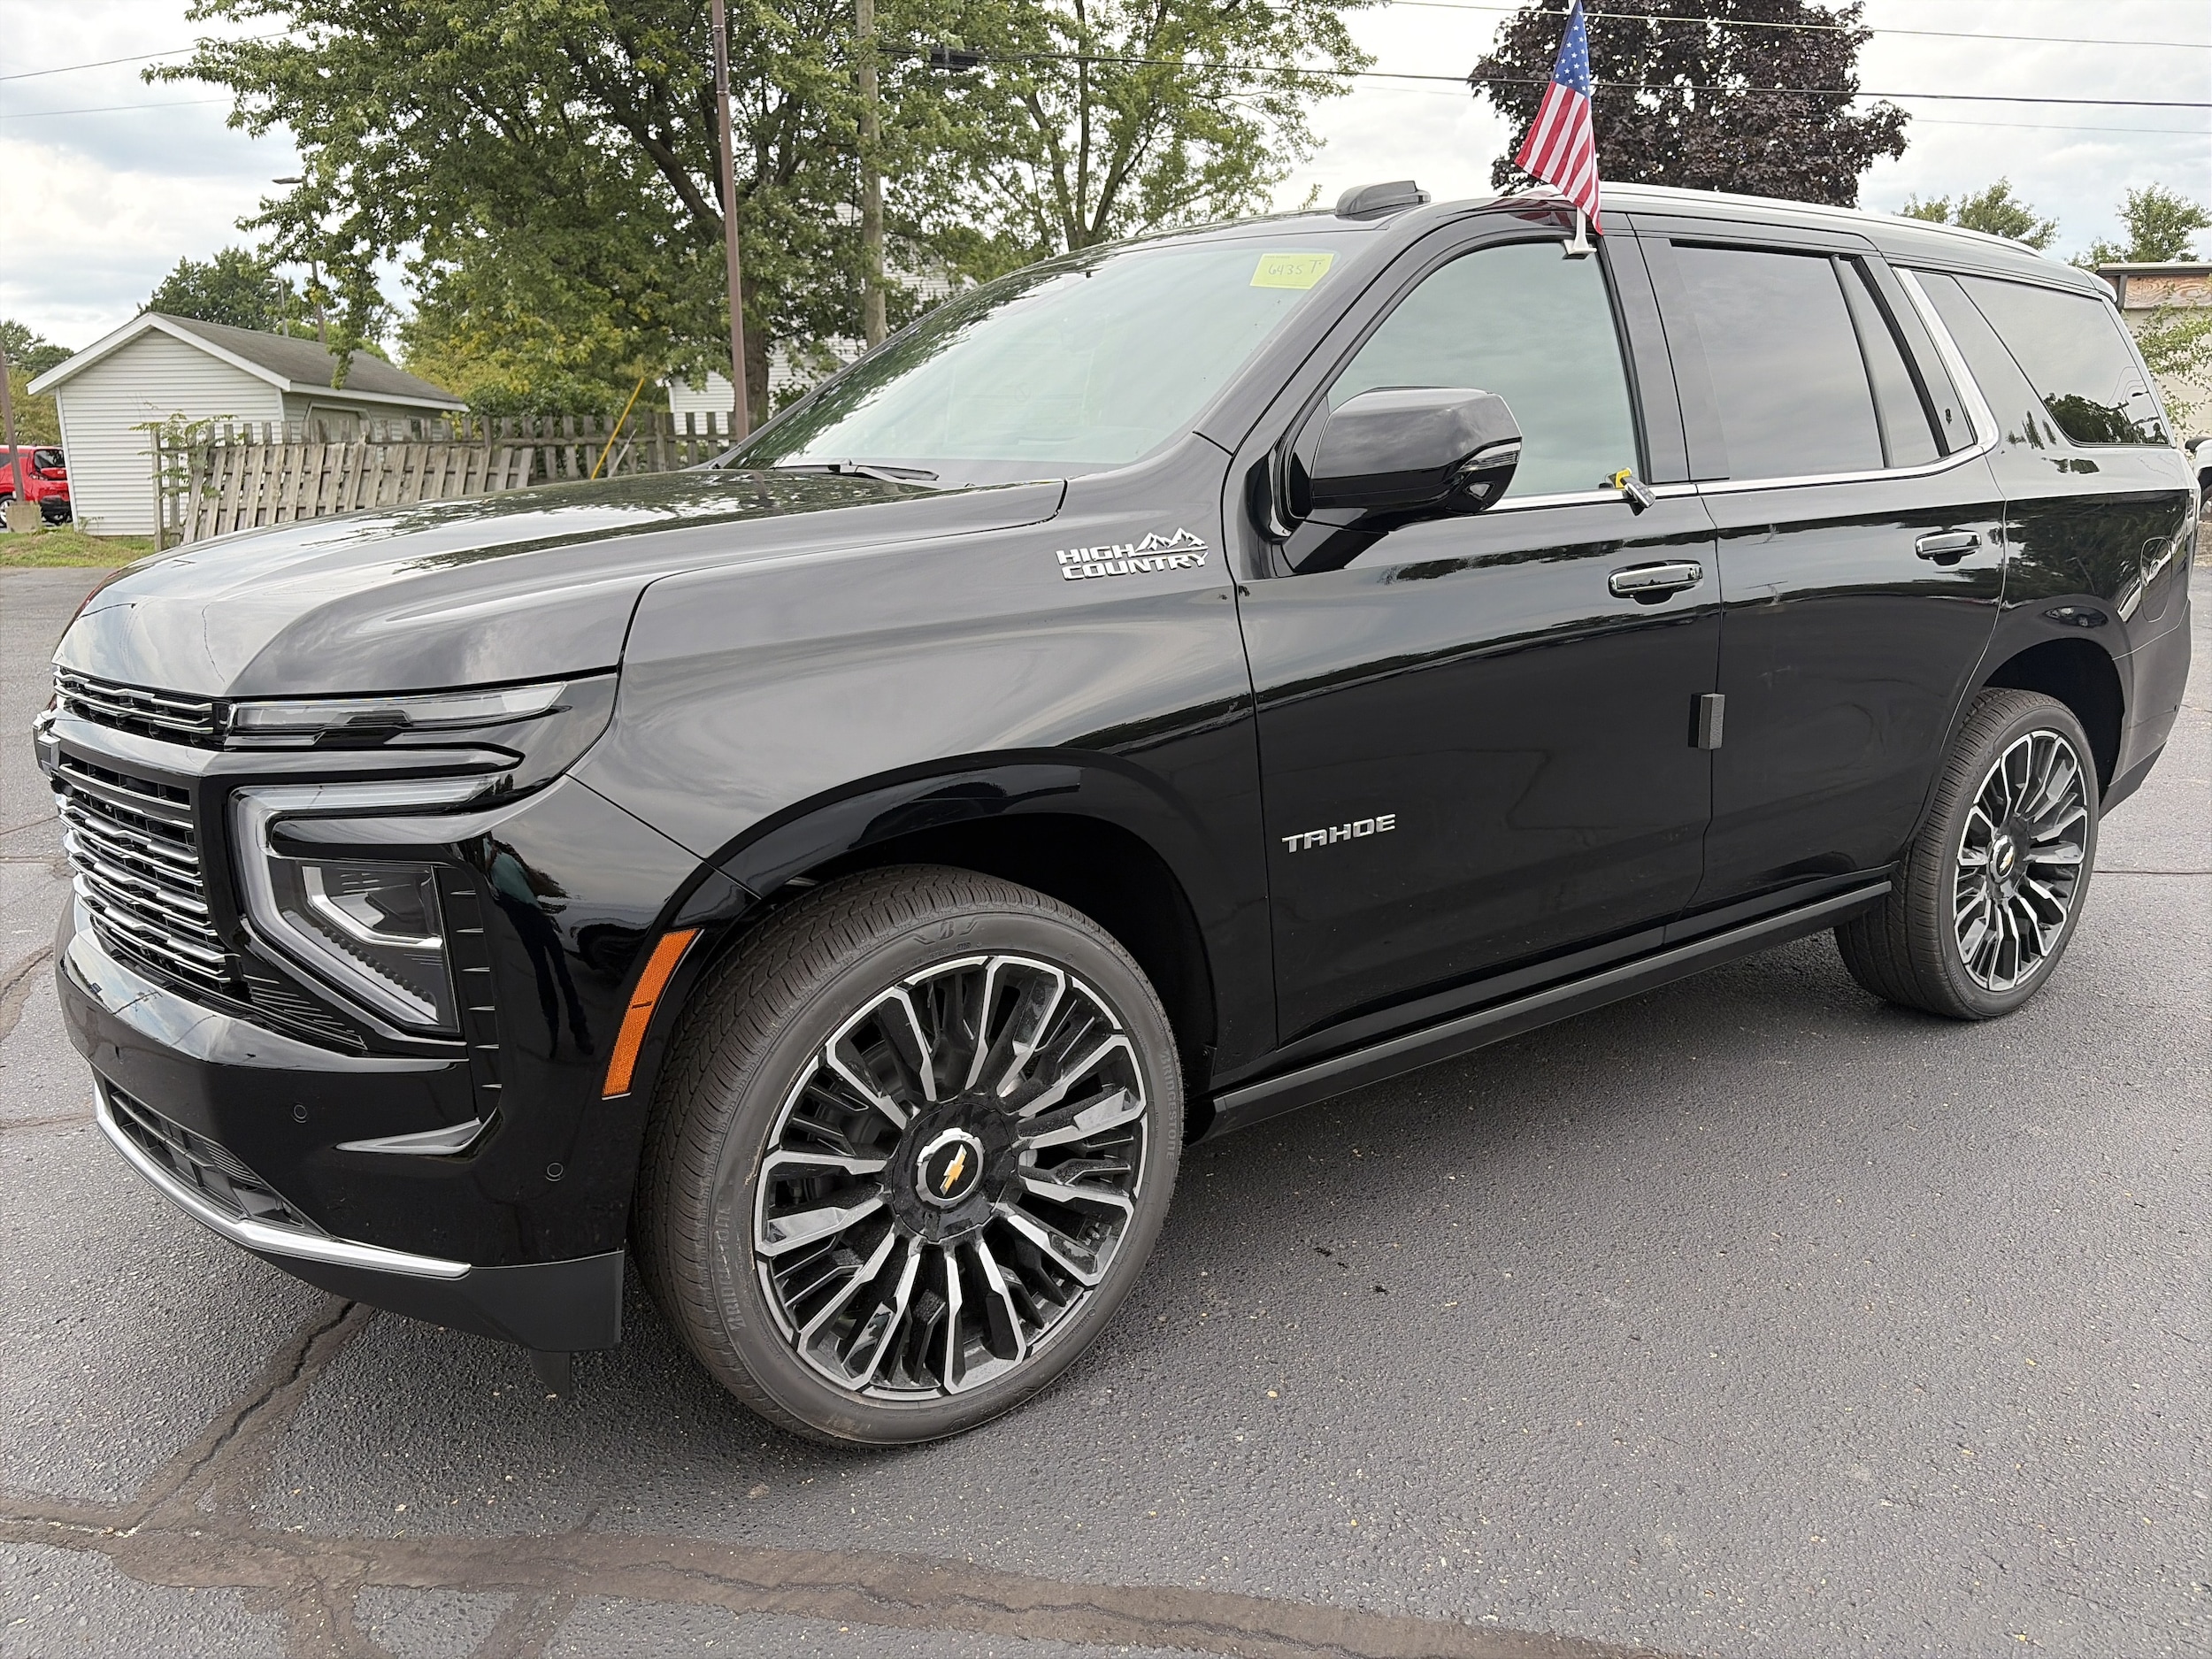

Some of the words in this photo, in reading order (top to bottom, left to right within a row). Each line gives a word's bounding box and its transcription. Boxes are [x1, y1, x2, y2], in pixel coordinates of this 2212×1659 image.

[1056, 543, 1134, 565] HIGH
[1061, 552, 1209, 580] COUNTRY
[1281, 813, 1395, 853] TAHOE
[1160, 1049, 1177, 1161] BRIDGESTONE
